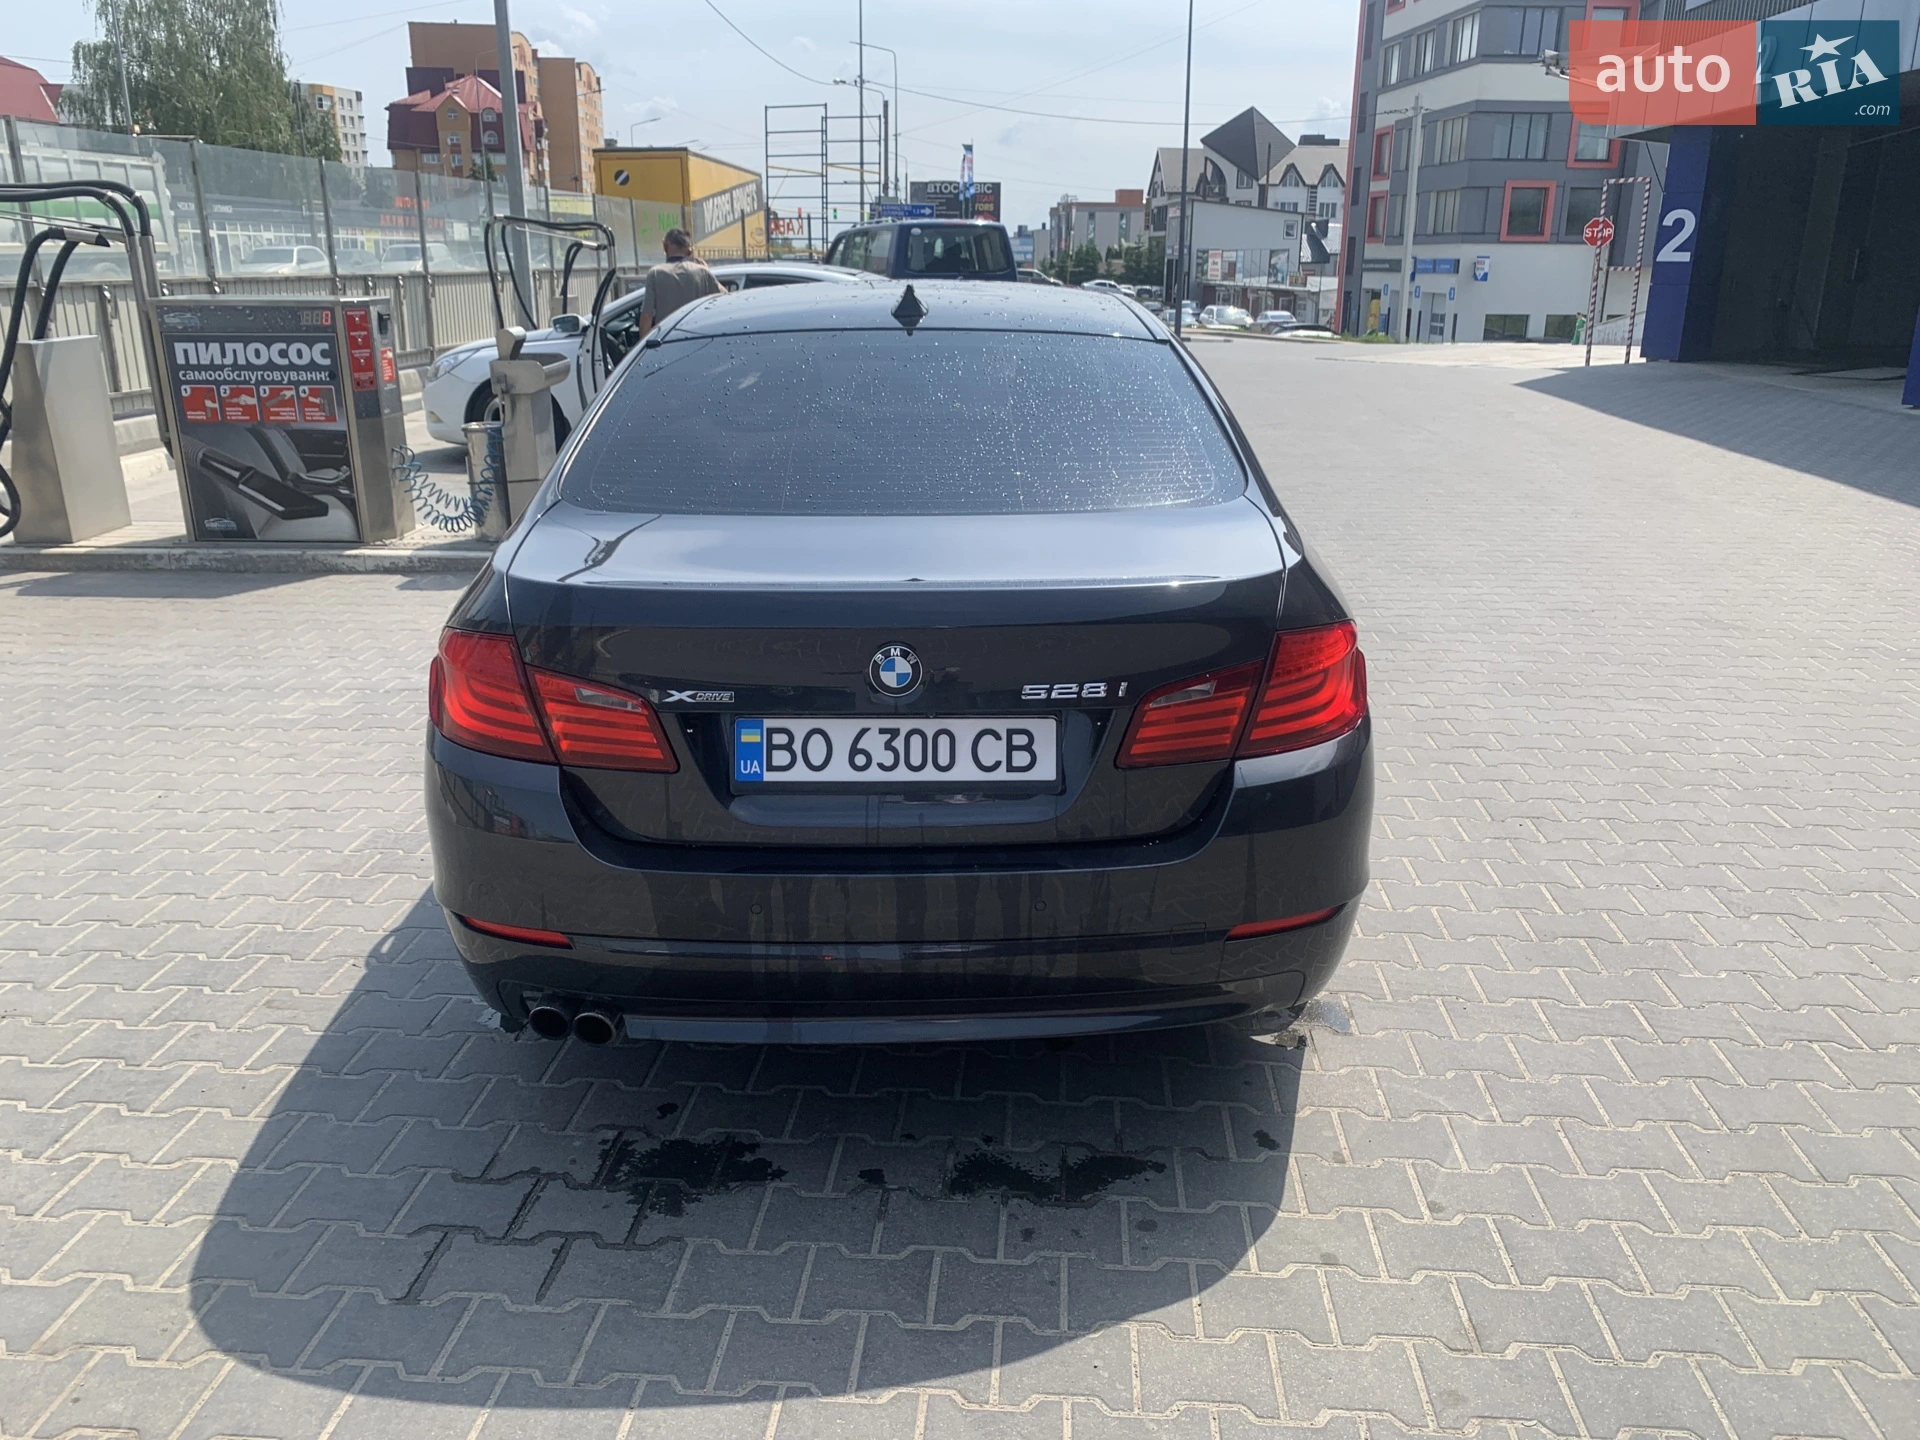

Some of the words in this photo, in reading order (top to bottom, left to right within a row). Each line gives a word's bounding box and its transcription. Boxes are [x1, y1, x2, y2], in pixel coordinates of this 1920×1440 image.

[1656, 209, 1697, 263] 2
[173, 341, 332, 366] ПИЛОСОС
[874, 647, 918, 665] BMW
[765, 727, 833, 773] BO
[848, 727, 956, 773] 6300
[970, 727, 1037, 773] CB
[740, 761, 761, 774] UA
